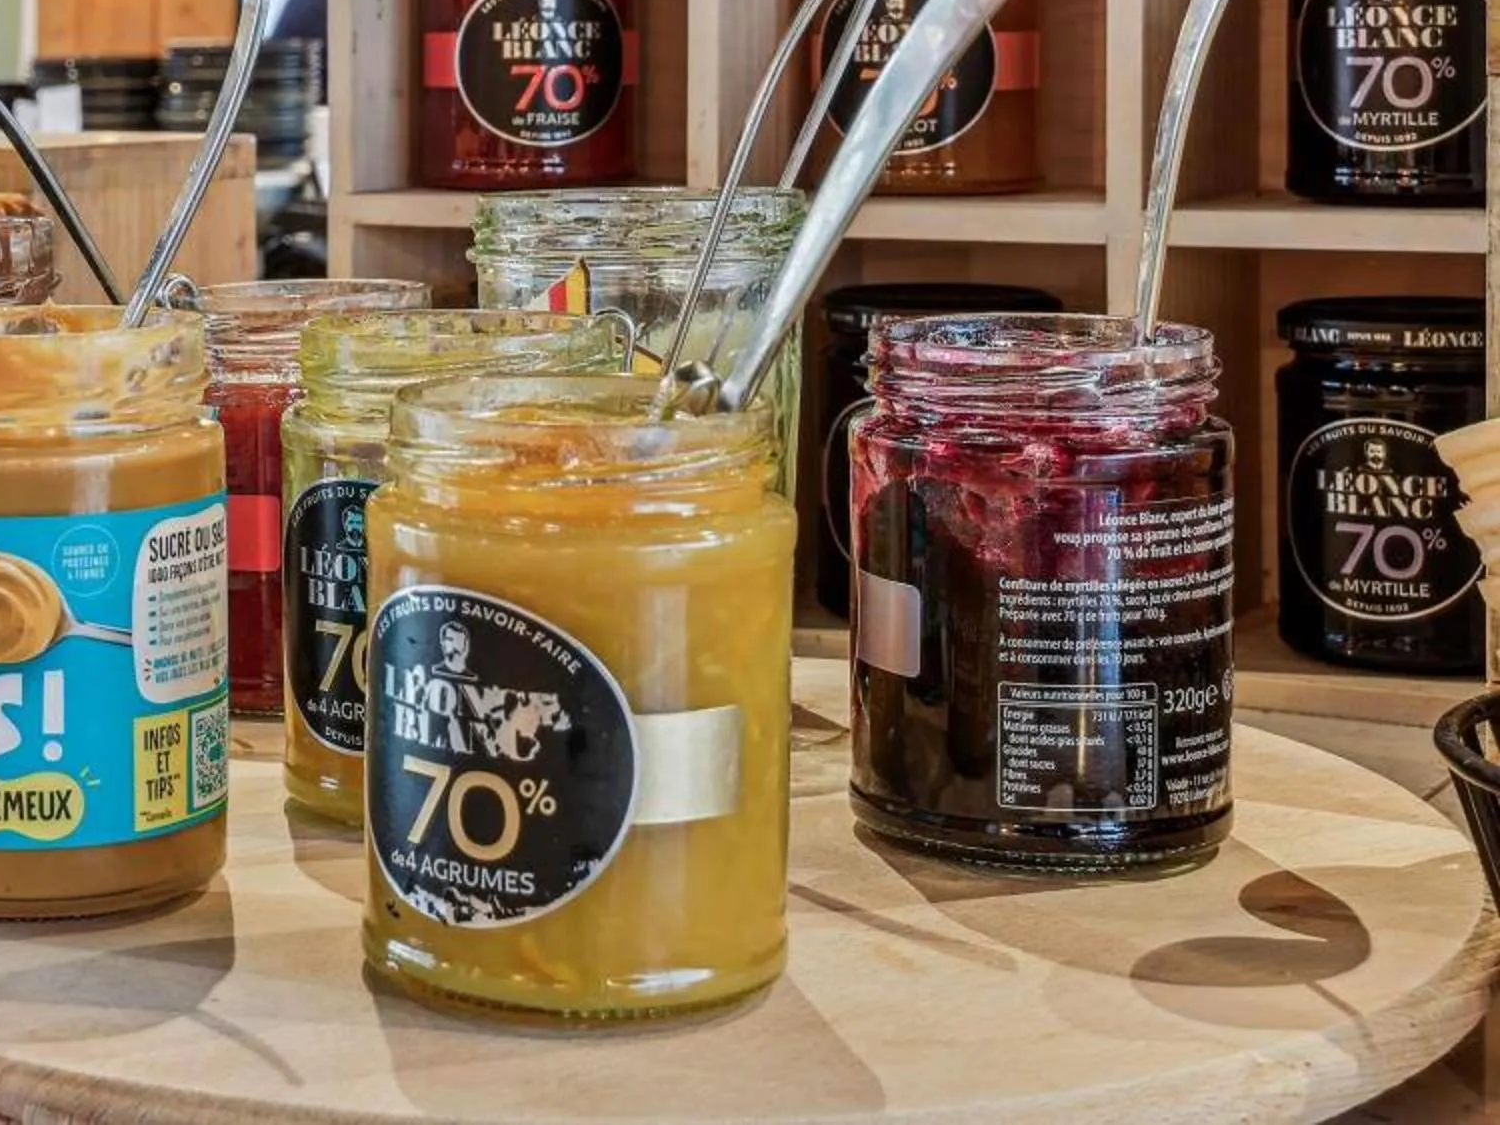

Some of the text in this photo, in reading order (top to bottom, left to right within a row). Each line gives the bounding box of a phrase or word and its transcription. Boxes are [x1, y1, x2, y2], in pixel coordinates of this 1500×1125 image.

[1327, 0, 1458, 27] LÉONCE
[492, 16, 600, 42] LÉONCE
[1336, 27, 1443, 49] BLANC
[502, 40, 591, 60] BLANC
[527, 111, 580, 126] FRAISE
[1353, 111, 1439, 126] MYRTILLE
[1403, 327, 1485, 349] LÉONCE
[1358, 424, 1377, 434] DU
[337, 486, 355, 498] DU
[1316, 468, 1447, 497] LÉONCE
[1325, 492, 1433, 519] BLANC
[149, 526, 191, 562] SUCRÉ
[1054, 532, 1081, 544] vous
[1083, 530, 1129, 547] propose
[1143, 527, 1181, 545] gamme
[1136, 545, 1149, 560] de
[308, 578, 366, 613] BLA
[999, 577, 1049, 592] Confiture
[1050, 578, 1063, 592] de
[1343, 577, 1431, 598] MYRTILLE
[390, 596, 430, 623] FRUITS
[433, 597, 456, 613] DU
[461, 600, 582, 676] SAVOIR-FAIRE
[1062, 636, 1075, 649] de
[1017, 653, 1072, 665] consommer
[144, 722, 181, 751] INFOS
[157, 750, 171, 773] ET
[145, 774, 175, 802] TIPS
[403, 754, 556, 861] 70%
[391, 849, 535, 896] de 4 AGRUMES
